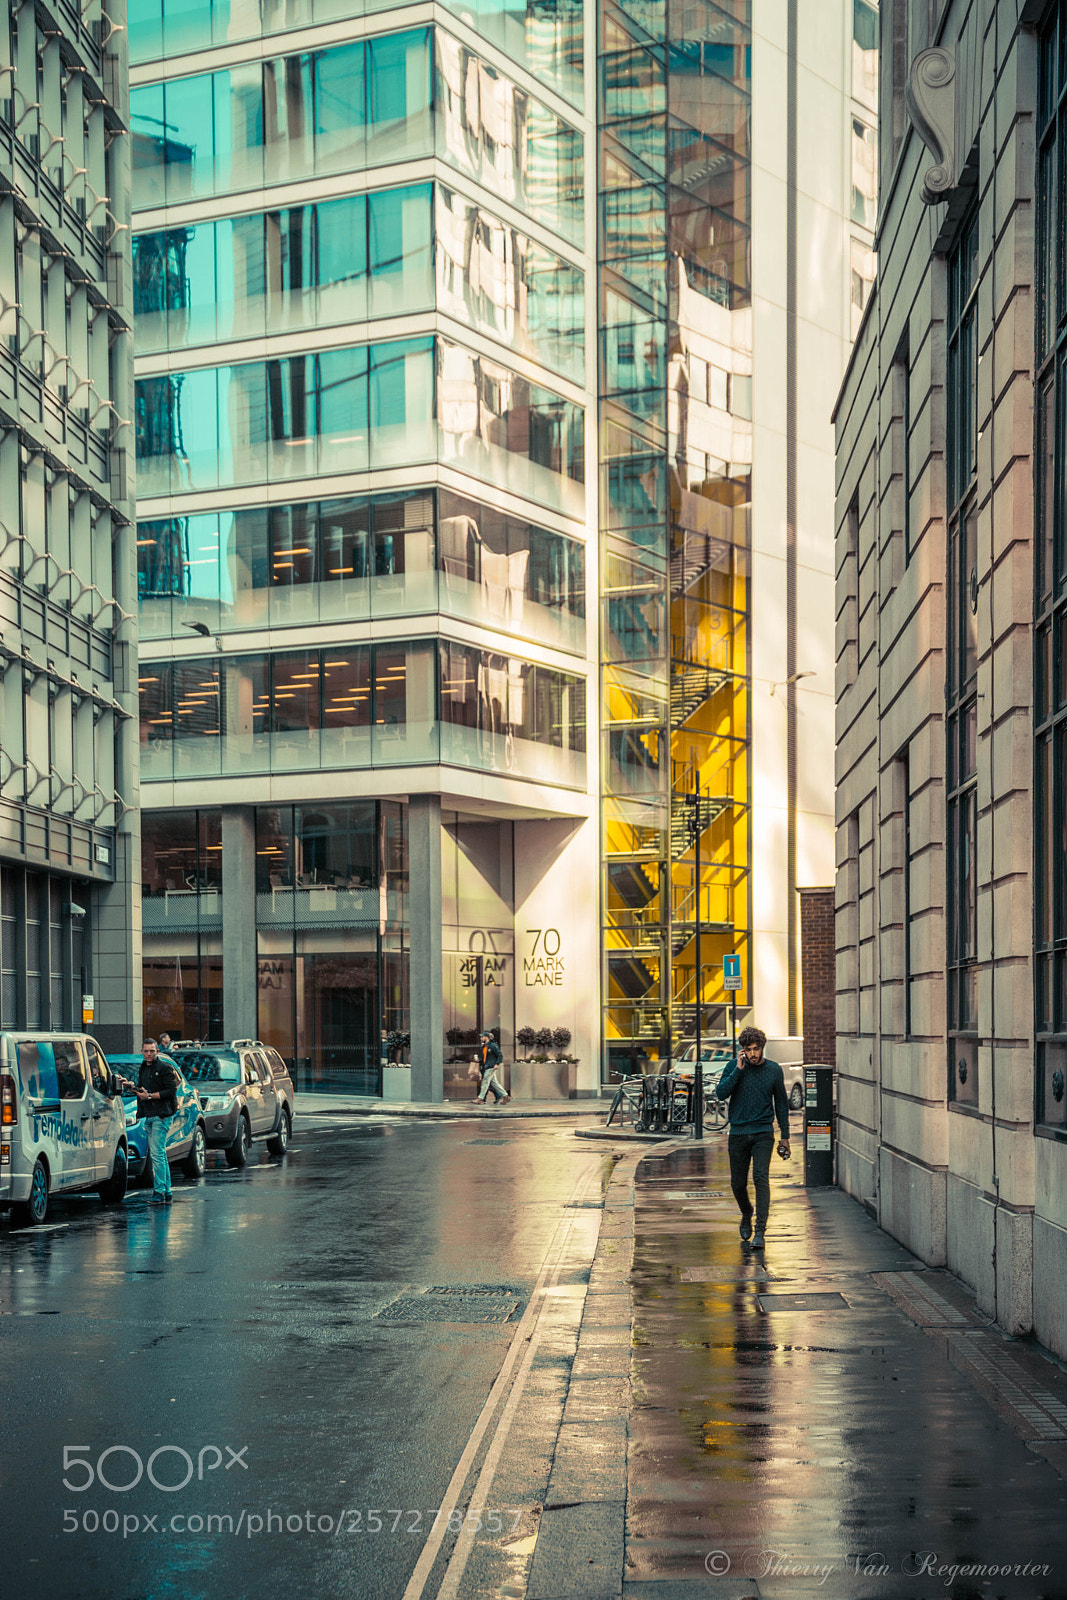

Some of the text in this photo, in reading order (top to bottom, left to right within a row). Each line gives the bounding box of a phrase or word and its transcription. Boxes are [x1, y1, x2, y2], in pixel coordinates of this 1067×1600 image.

[526, 928, 561, 956] 70
[523, 957, 566, 972] MARK
[525, 972, 563, 987] LANE
